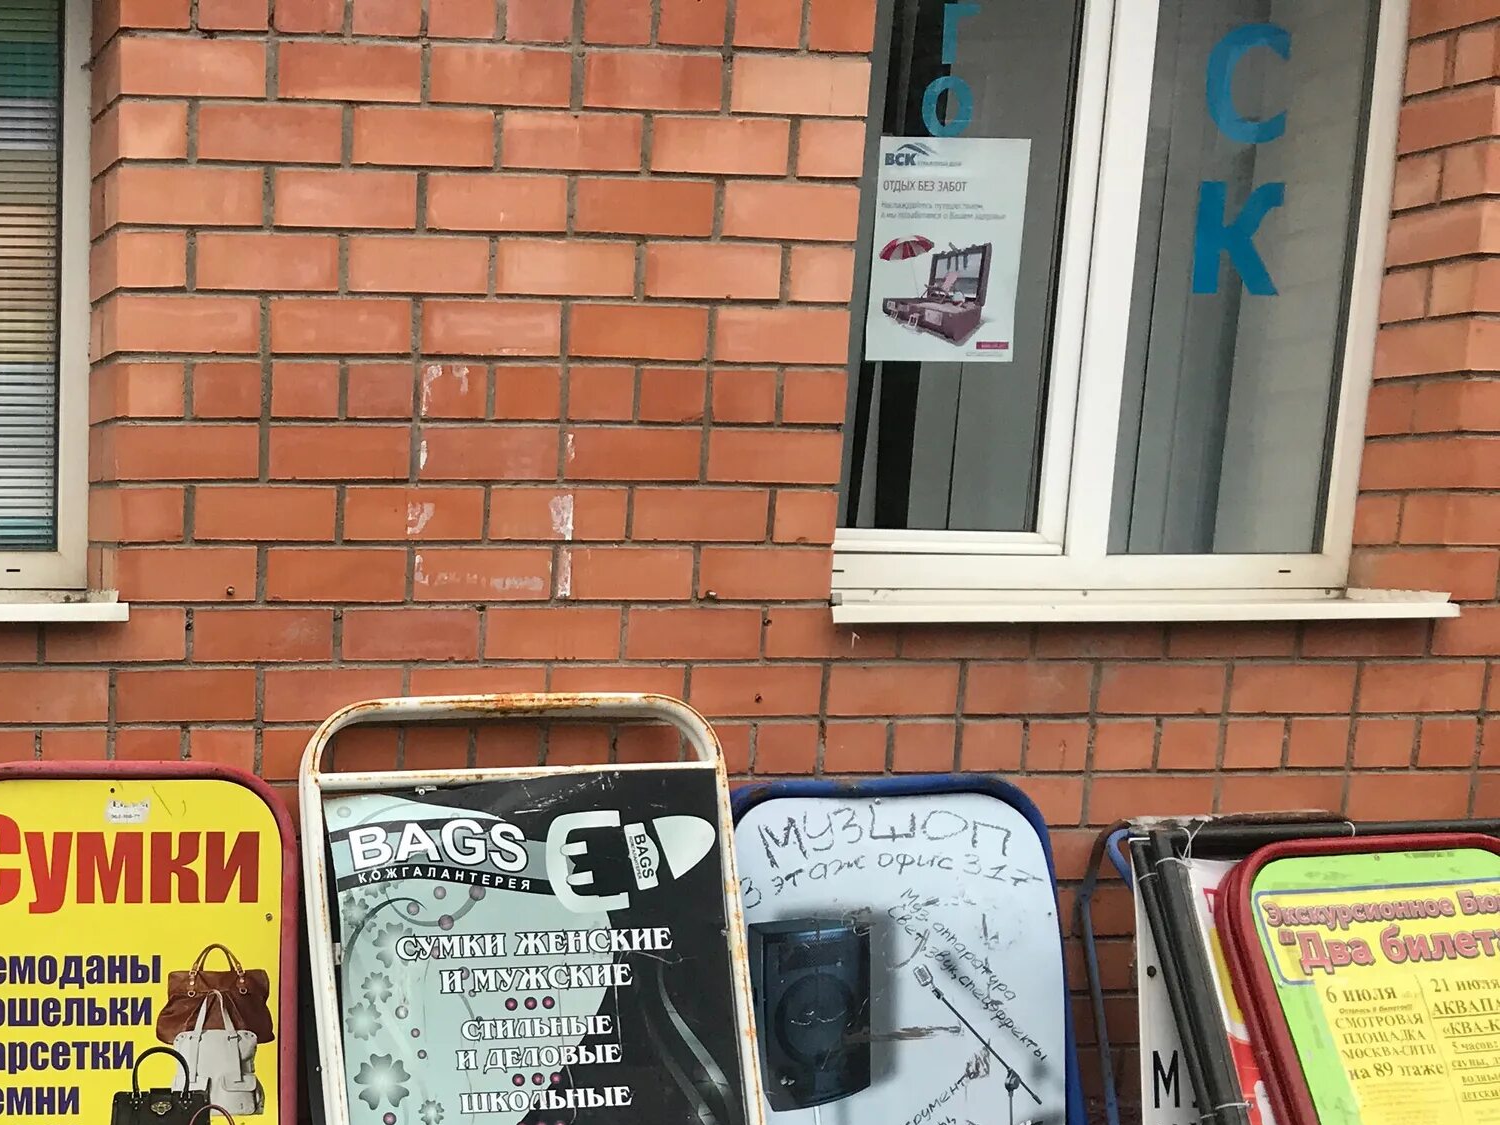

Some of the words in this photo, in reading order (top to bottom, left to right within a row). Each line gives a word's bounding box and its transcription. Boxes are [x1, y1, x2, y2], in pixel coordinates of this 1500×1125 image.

[885, 153, 917, 166] ВСК
[883, 180, 915, 192] ОТДЫХ
[918, 181, 935, 192] БЕЗ
[938, 181, 968, 192] ЗАБОТ
[347, 818, 529, 873] BAGS
[634, 834, 654, 878] BAGS
[878, 853, 954, 875] офис
[357, 867, 531, 891] КОЖГАЛАНТЕРЕЯ
[1263, 897, 1456, 930] Экскурсионное
[1456, 889, 1500, 915] Бю
[395, 931, 506, 961] СУМКИ
[514, 927, 673, 956] ЖЕНСКИЕ
[1380, 924, 1500, 963] билет
[439, 969, 466, 994] И
[471, 963, 634, 995] МУЖСКИЕ
[1430, 978, 1451, 993] 21
[1326, 985, 1338, 1003] 6
[1342, 987, 1397, 1002] июля
[461, 1015, 613, 1042] СТИЛЬНЫЕ
[1334, 1013, 1424, 1029] СМОТРОВАЯ
[1342, 1028, 1426, 1045] ПЛОЩАДКА
[456, 1049, 478, 1070] И
[483, 1043, 622, 1073] ДЕЛОВЫЕ
[1341, 1044, 1437, 1060] МОСКВА-СИТИ
[1348, 1067, 1371, 1080] на
[1373, 1061, 1393, 1077] 89
[459, 1085, 634, 1114] ШКОЛЬНЫЕ
